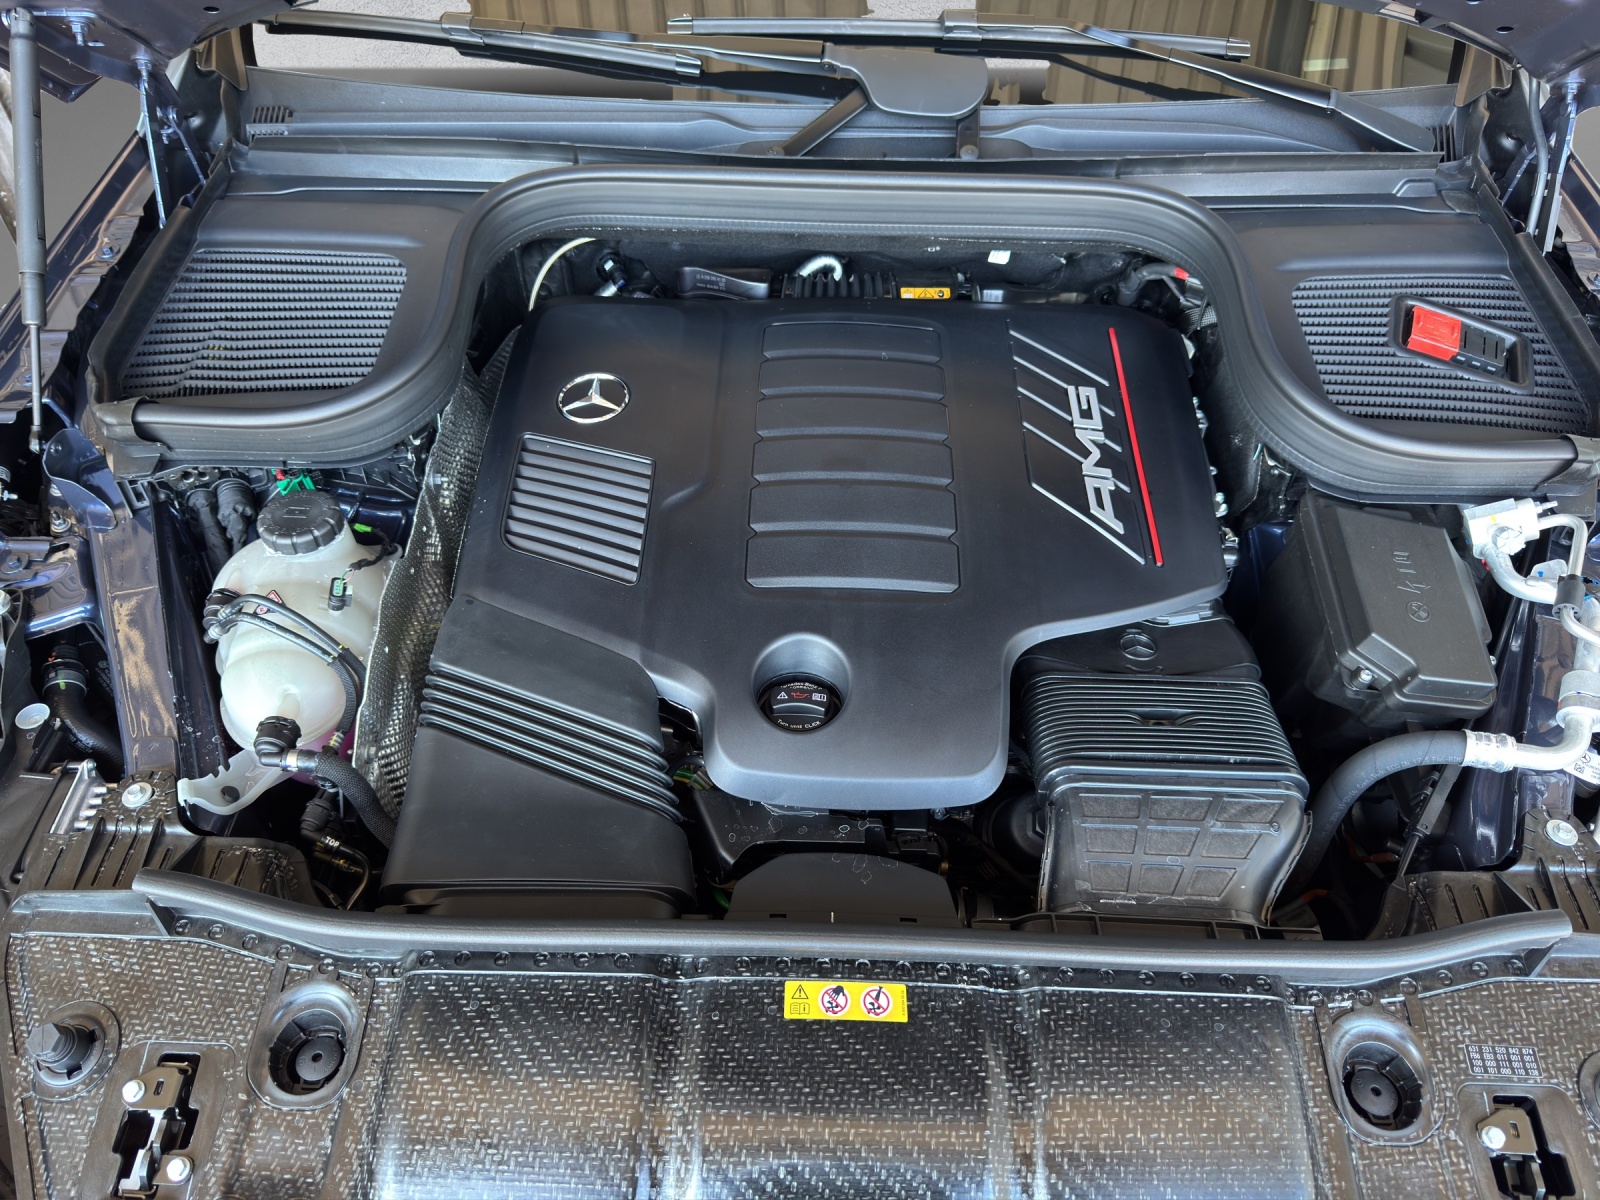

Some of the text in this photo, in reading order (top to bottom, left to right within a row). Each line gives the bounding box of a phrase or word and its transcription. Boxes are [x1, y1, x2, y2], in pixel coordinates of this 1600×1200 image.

[1067, 385, 1125, 535] AMG
[778, 718, 788, 726] Turn
[326, 836, 340, 847] TOP
